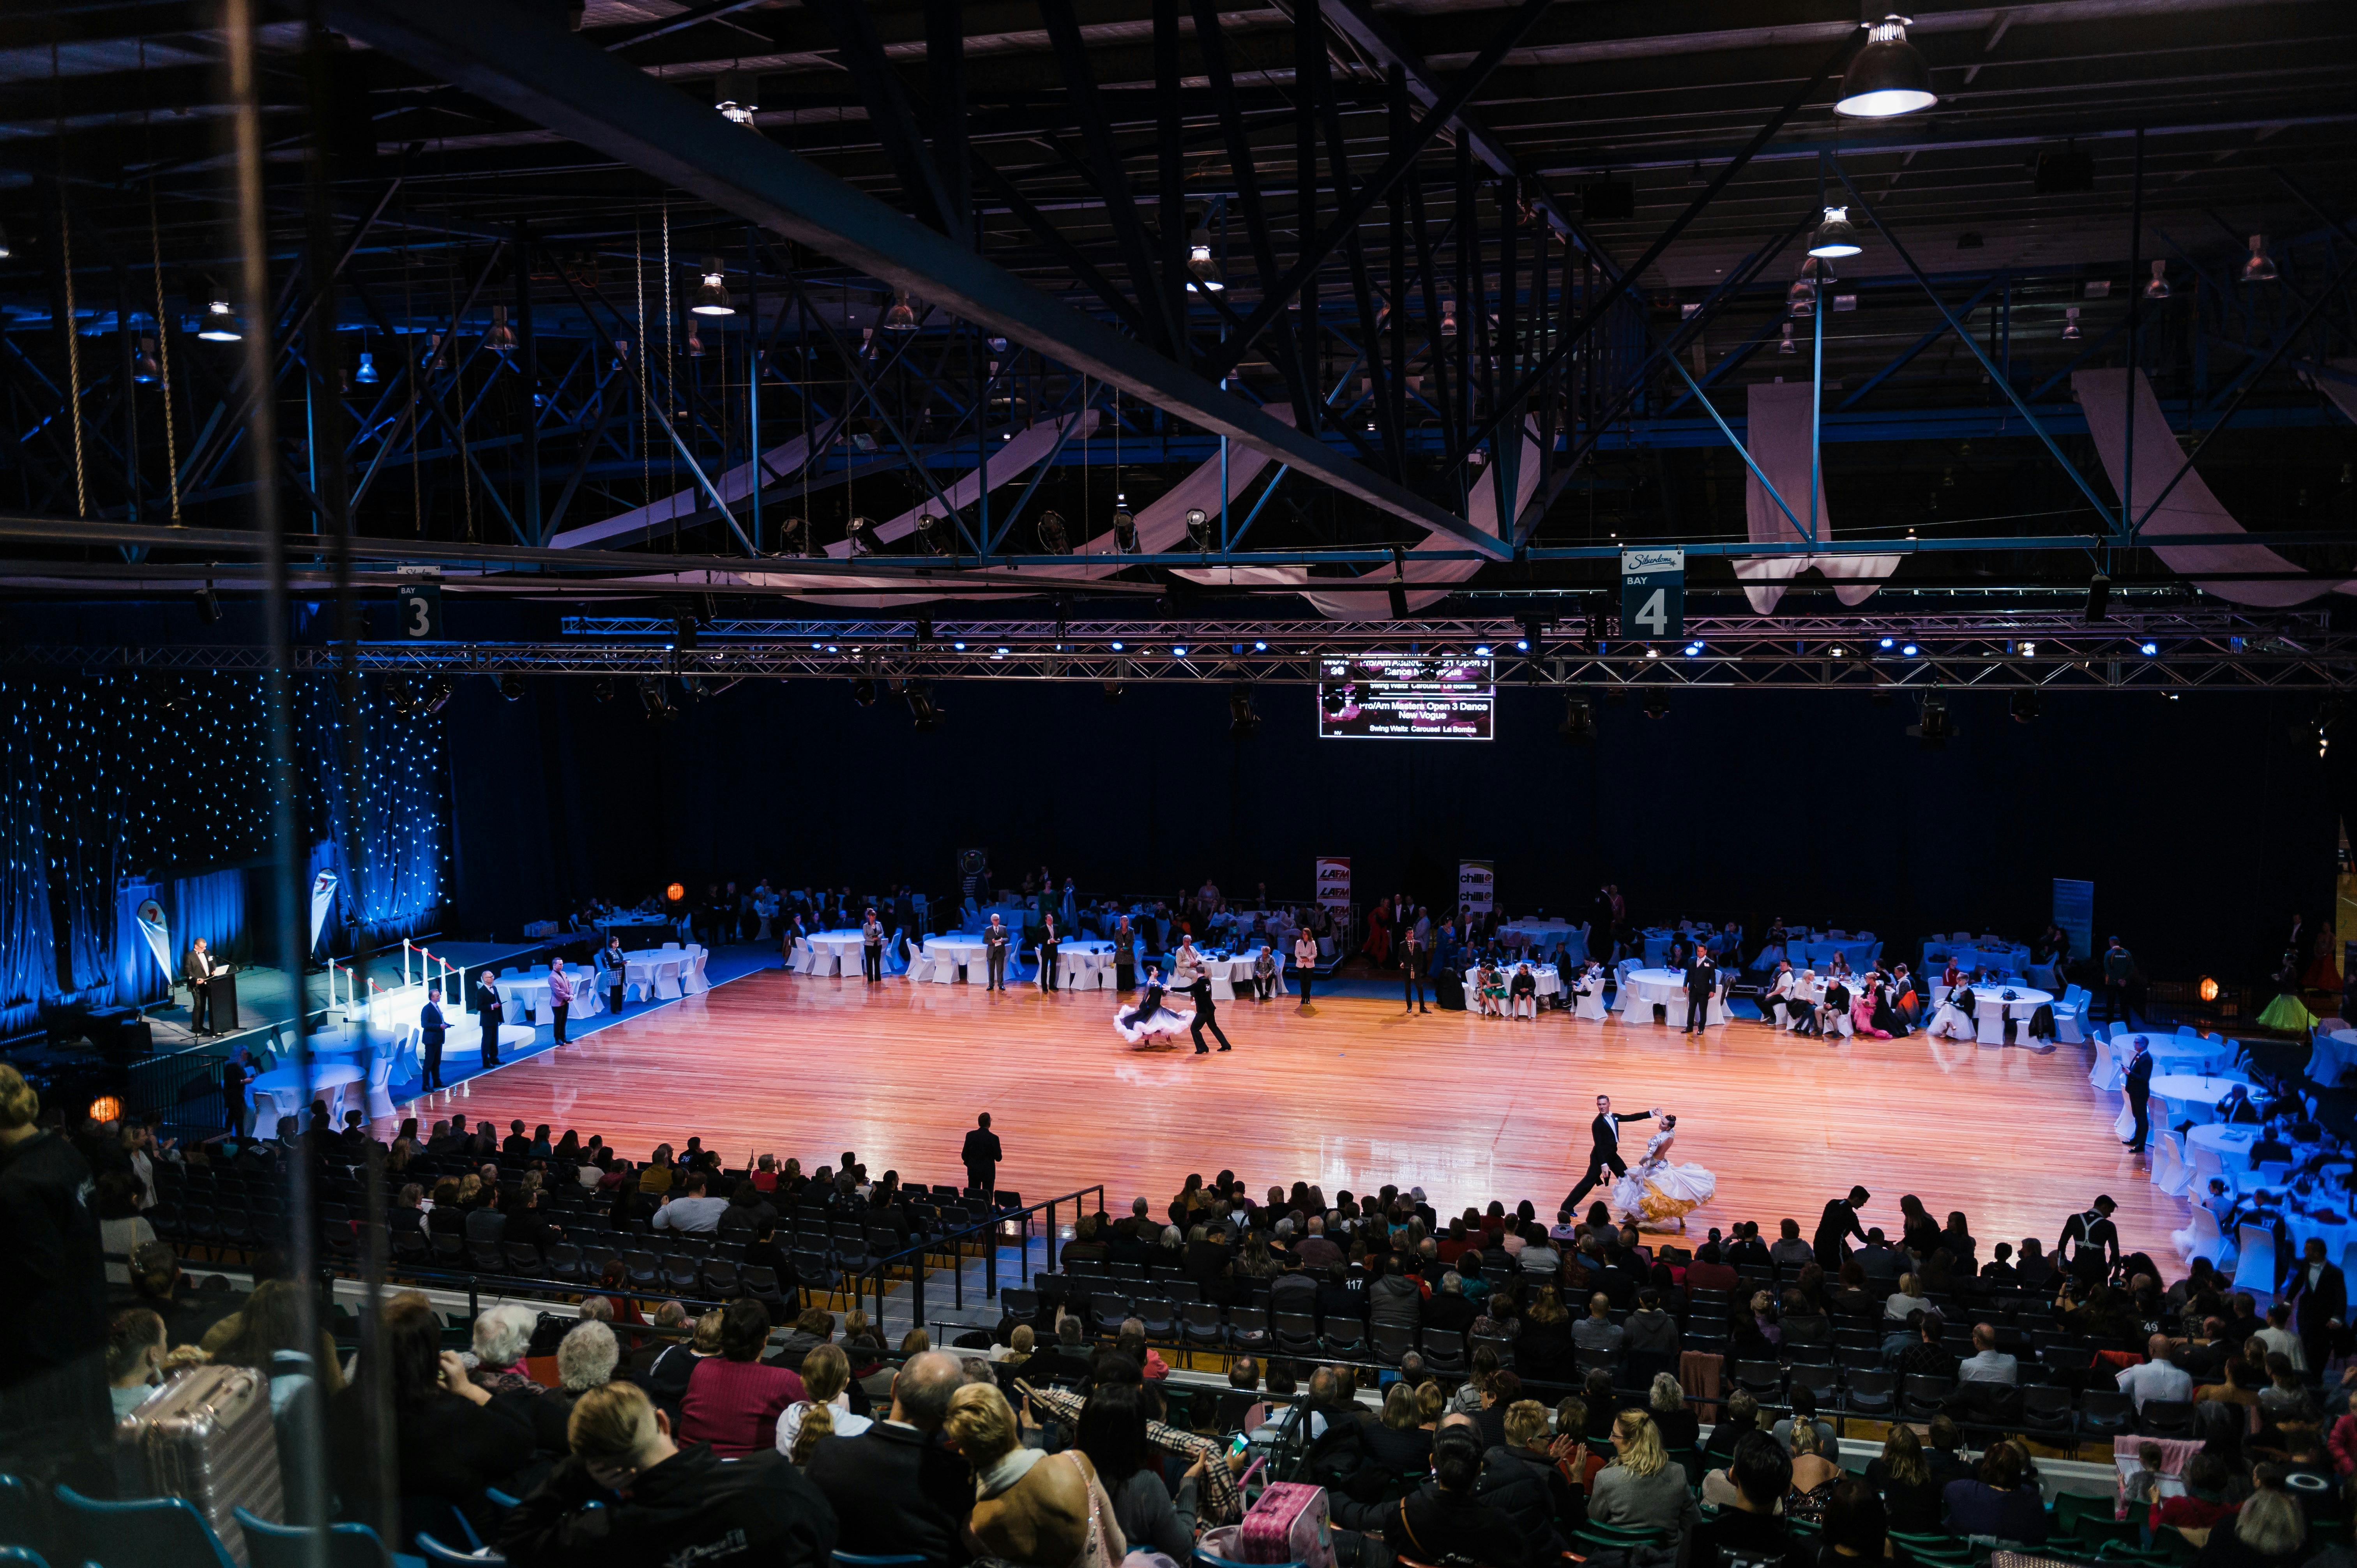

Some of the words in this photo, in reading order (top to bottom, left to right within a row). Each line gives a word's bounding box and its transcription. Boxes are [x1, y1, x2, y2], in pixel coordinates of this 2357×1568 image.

[1629, 554, 1672, 570] Silverdome
[1635, 588, 1667, 635] 4
[409, 598, 429, 637] 3
[1385, 667, 1412, 676] Dance
[1392, 702, 1425, 710] Masters
[1427, 702, 1450, 712] Open
[1460, 702, 1488, 711] Dance
[1419, 711, 1447, 720] Vogue
[1320, 869, 1349, 878] LAFM
[1460, 873, 1484, 883] chilli
[1320, 887, 1349, 896] LAFM
[1459, 891, 1484, 902] chilli
[1324, 906, 1349, 915] AFM
[1346, 1280, 1362, 1289] 117
[2144, 1322, 2158, 1332] 49
